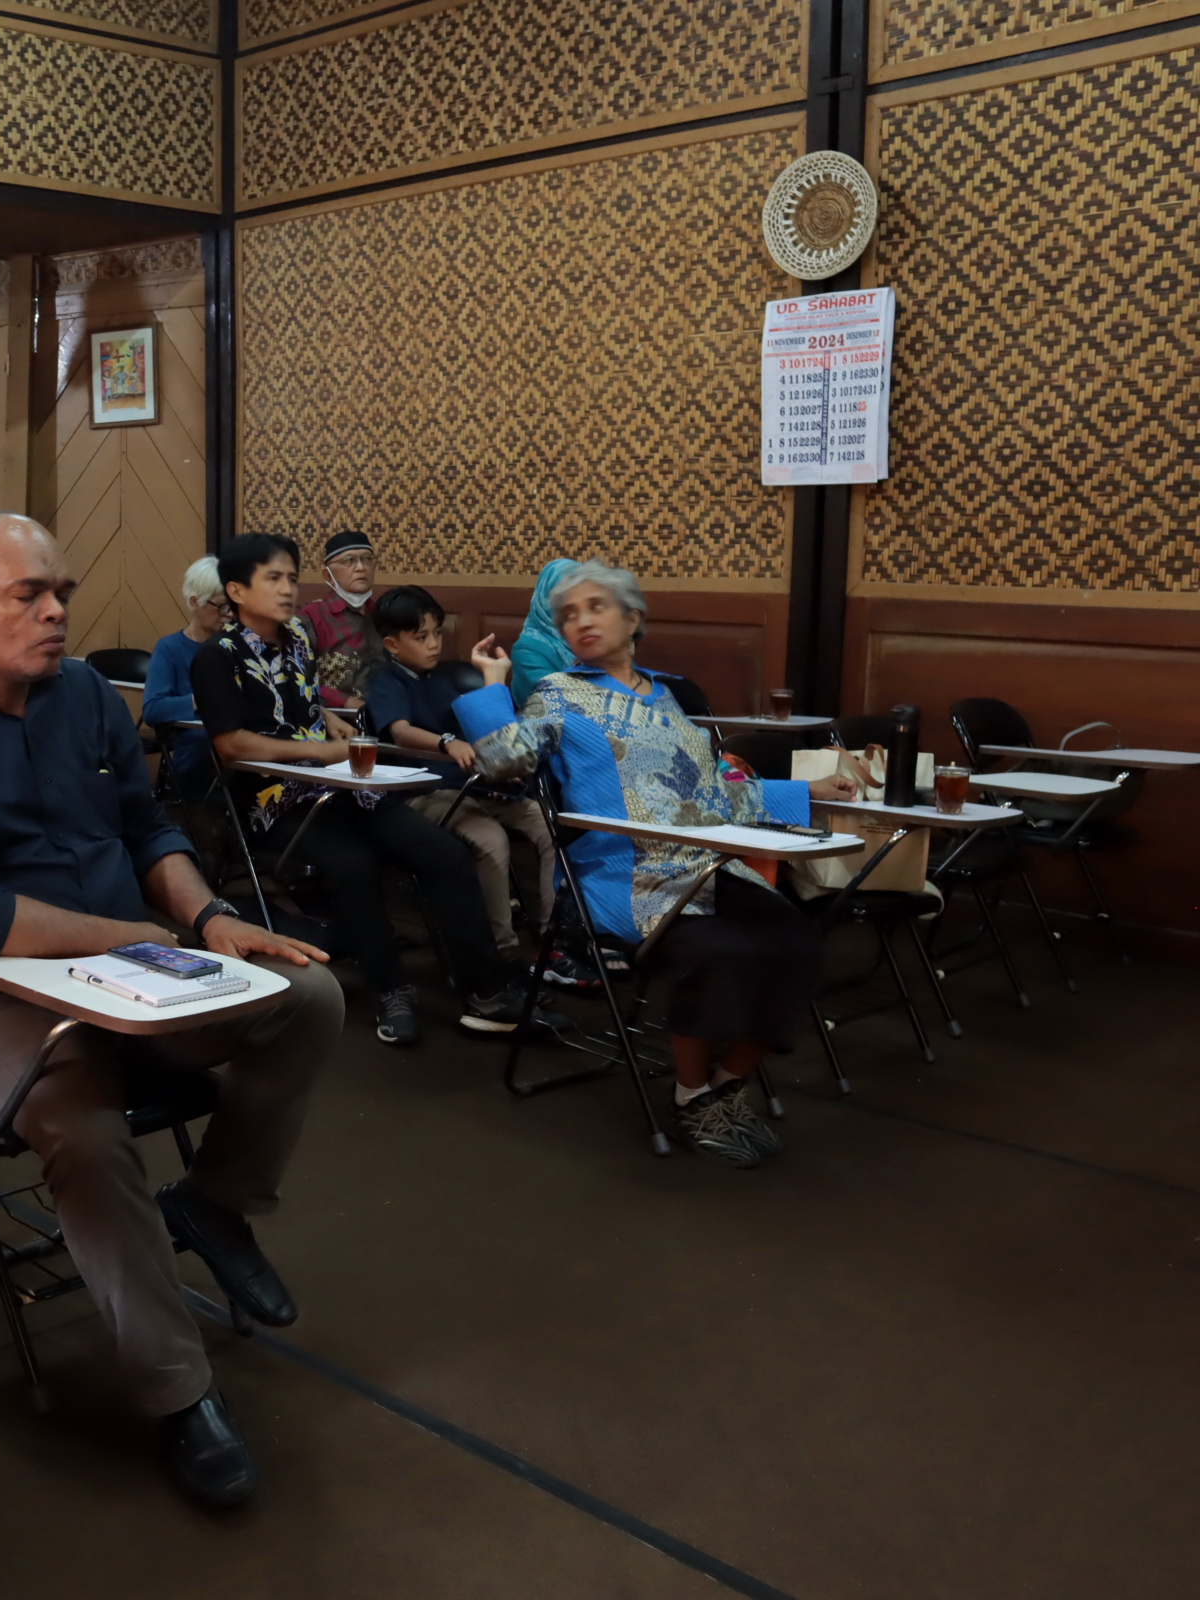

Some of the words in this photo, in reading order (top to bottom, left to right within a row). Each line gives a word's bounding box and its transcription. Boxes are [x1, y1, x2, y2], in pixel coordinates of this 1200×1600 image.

[777, 303, 800, 314] UD.
[808, 294, 876, 311] SAHABAT
[847, 330, 872, 340] DESEMBER
[775, 337, 805, 346] NOVEMBER
[808, 334, 845, 349] 2024
[790, 359, 800, 368] 10
[802, 358, 812, 368] 17
[813, 357, 824, 367] 24
[851, 354, 859, 363] 15
[859, 353, 869, 362] 22
[870, 352, 879, 361] 29
[790, 375, 799, 384] 11
[802, 374, 811, 383] 18
[812, 373, 822, 383] 25
[850, 370, 858, 380] 16
[859, 369, 868, 379] 23
[868, 368, 878, 378] 30
[789, 391, 800, 400] 12
[802, 390, 811, 399] 19
[812, 389, 822, 399] 26
[840, 387, 848, 397] 10
[849, 386, 858, 396] 17
[858, 385, 868, 395] 24
[868, 384, 877, 394] 31
[789, 407, 799, 416] 13
[800, 406, 811, 415] 20
[812, 405, 822, 414] 27
[839, 403, 847, 413] 11
[849, 402, 857, 412] 18
[858, 401, 866, 411] 25
[789, 423, 799, 431] 14
[800, 422, 809, 431] 21
[811, 421, 821, 430] 28
[839, 419, 847, 429] 12
[848, 418, 857, 428] 19
[857, 418, 866, 427] 26
[789, 438, 798, 447] 15
[799, 437, 809, 446] 22
[810, 437, 820, 446] 29
[838, 435, 847, 445] 13
[848, 435, 856, 444] 20
[857, 434, 865, 444] 27
[788, 454, 797, 463] 16
[799, 453, 809, 462] 23
[810, 453, 820, 462] 30
[837, 452, 846, 461] 14
[847, 451, 855, 461] 21
[856, 450, 865, 460] 28
